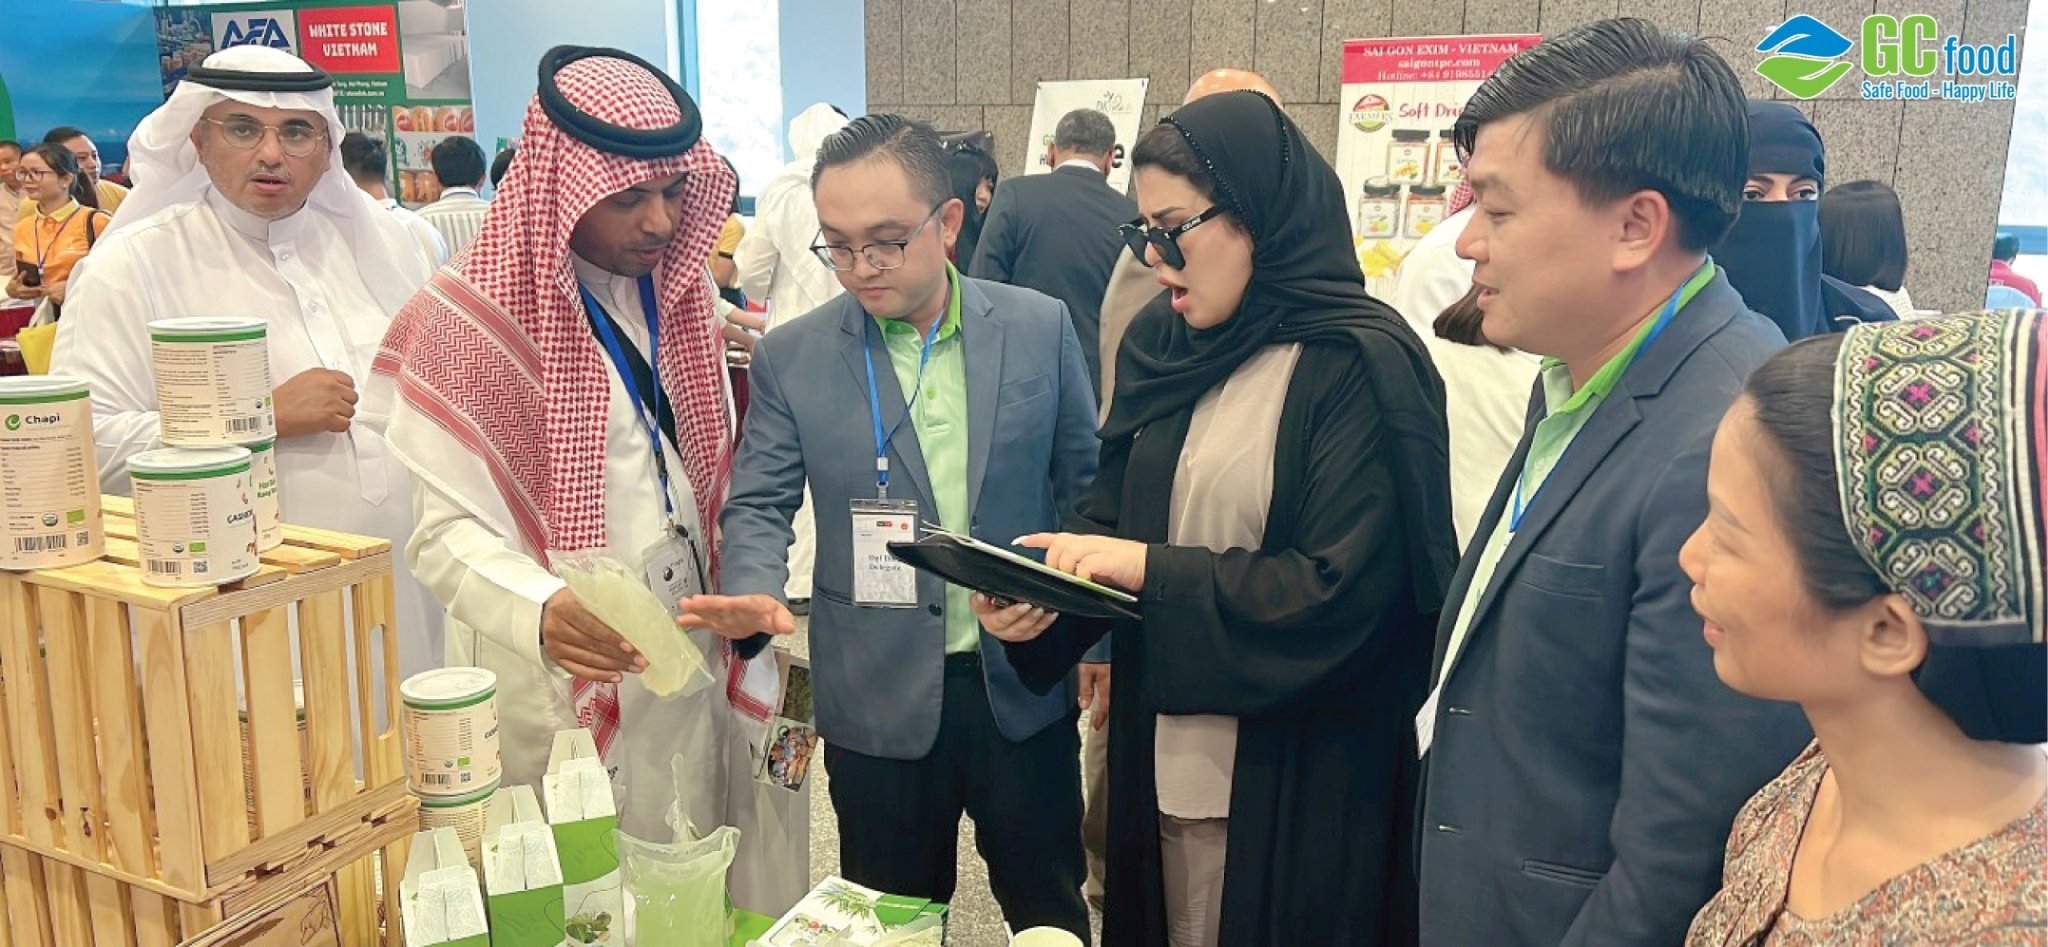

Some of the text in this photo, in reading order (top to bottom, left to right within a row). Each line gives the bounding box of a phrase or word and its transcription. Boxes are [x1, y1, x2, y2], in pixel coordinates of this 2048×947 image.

[309, 22, 388, 38] WHITE STONE
[322, 42, 378, 57] VIETNAM
[1363, 46, 1383, 57] SAI
[1386, 45, 1414, 56] GON
[1417, 44, 1449, 55] EXIM
[1459, 43, 1519, 54] VIETNAM
[1378, 71, 1418, 81] Hotline:
[1399, 103, 1430, 120] Soft
[25, 412, 61, 425] Chapi
